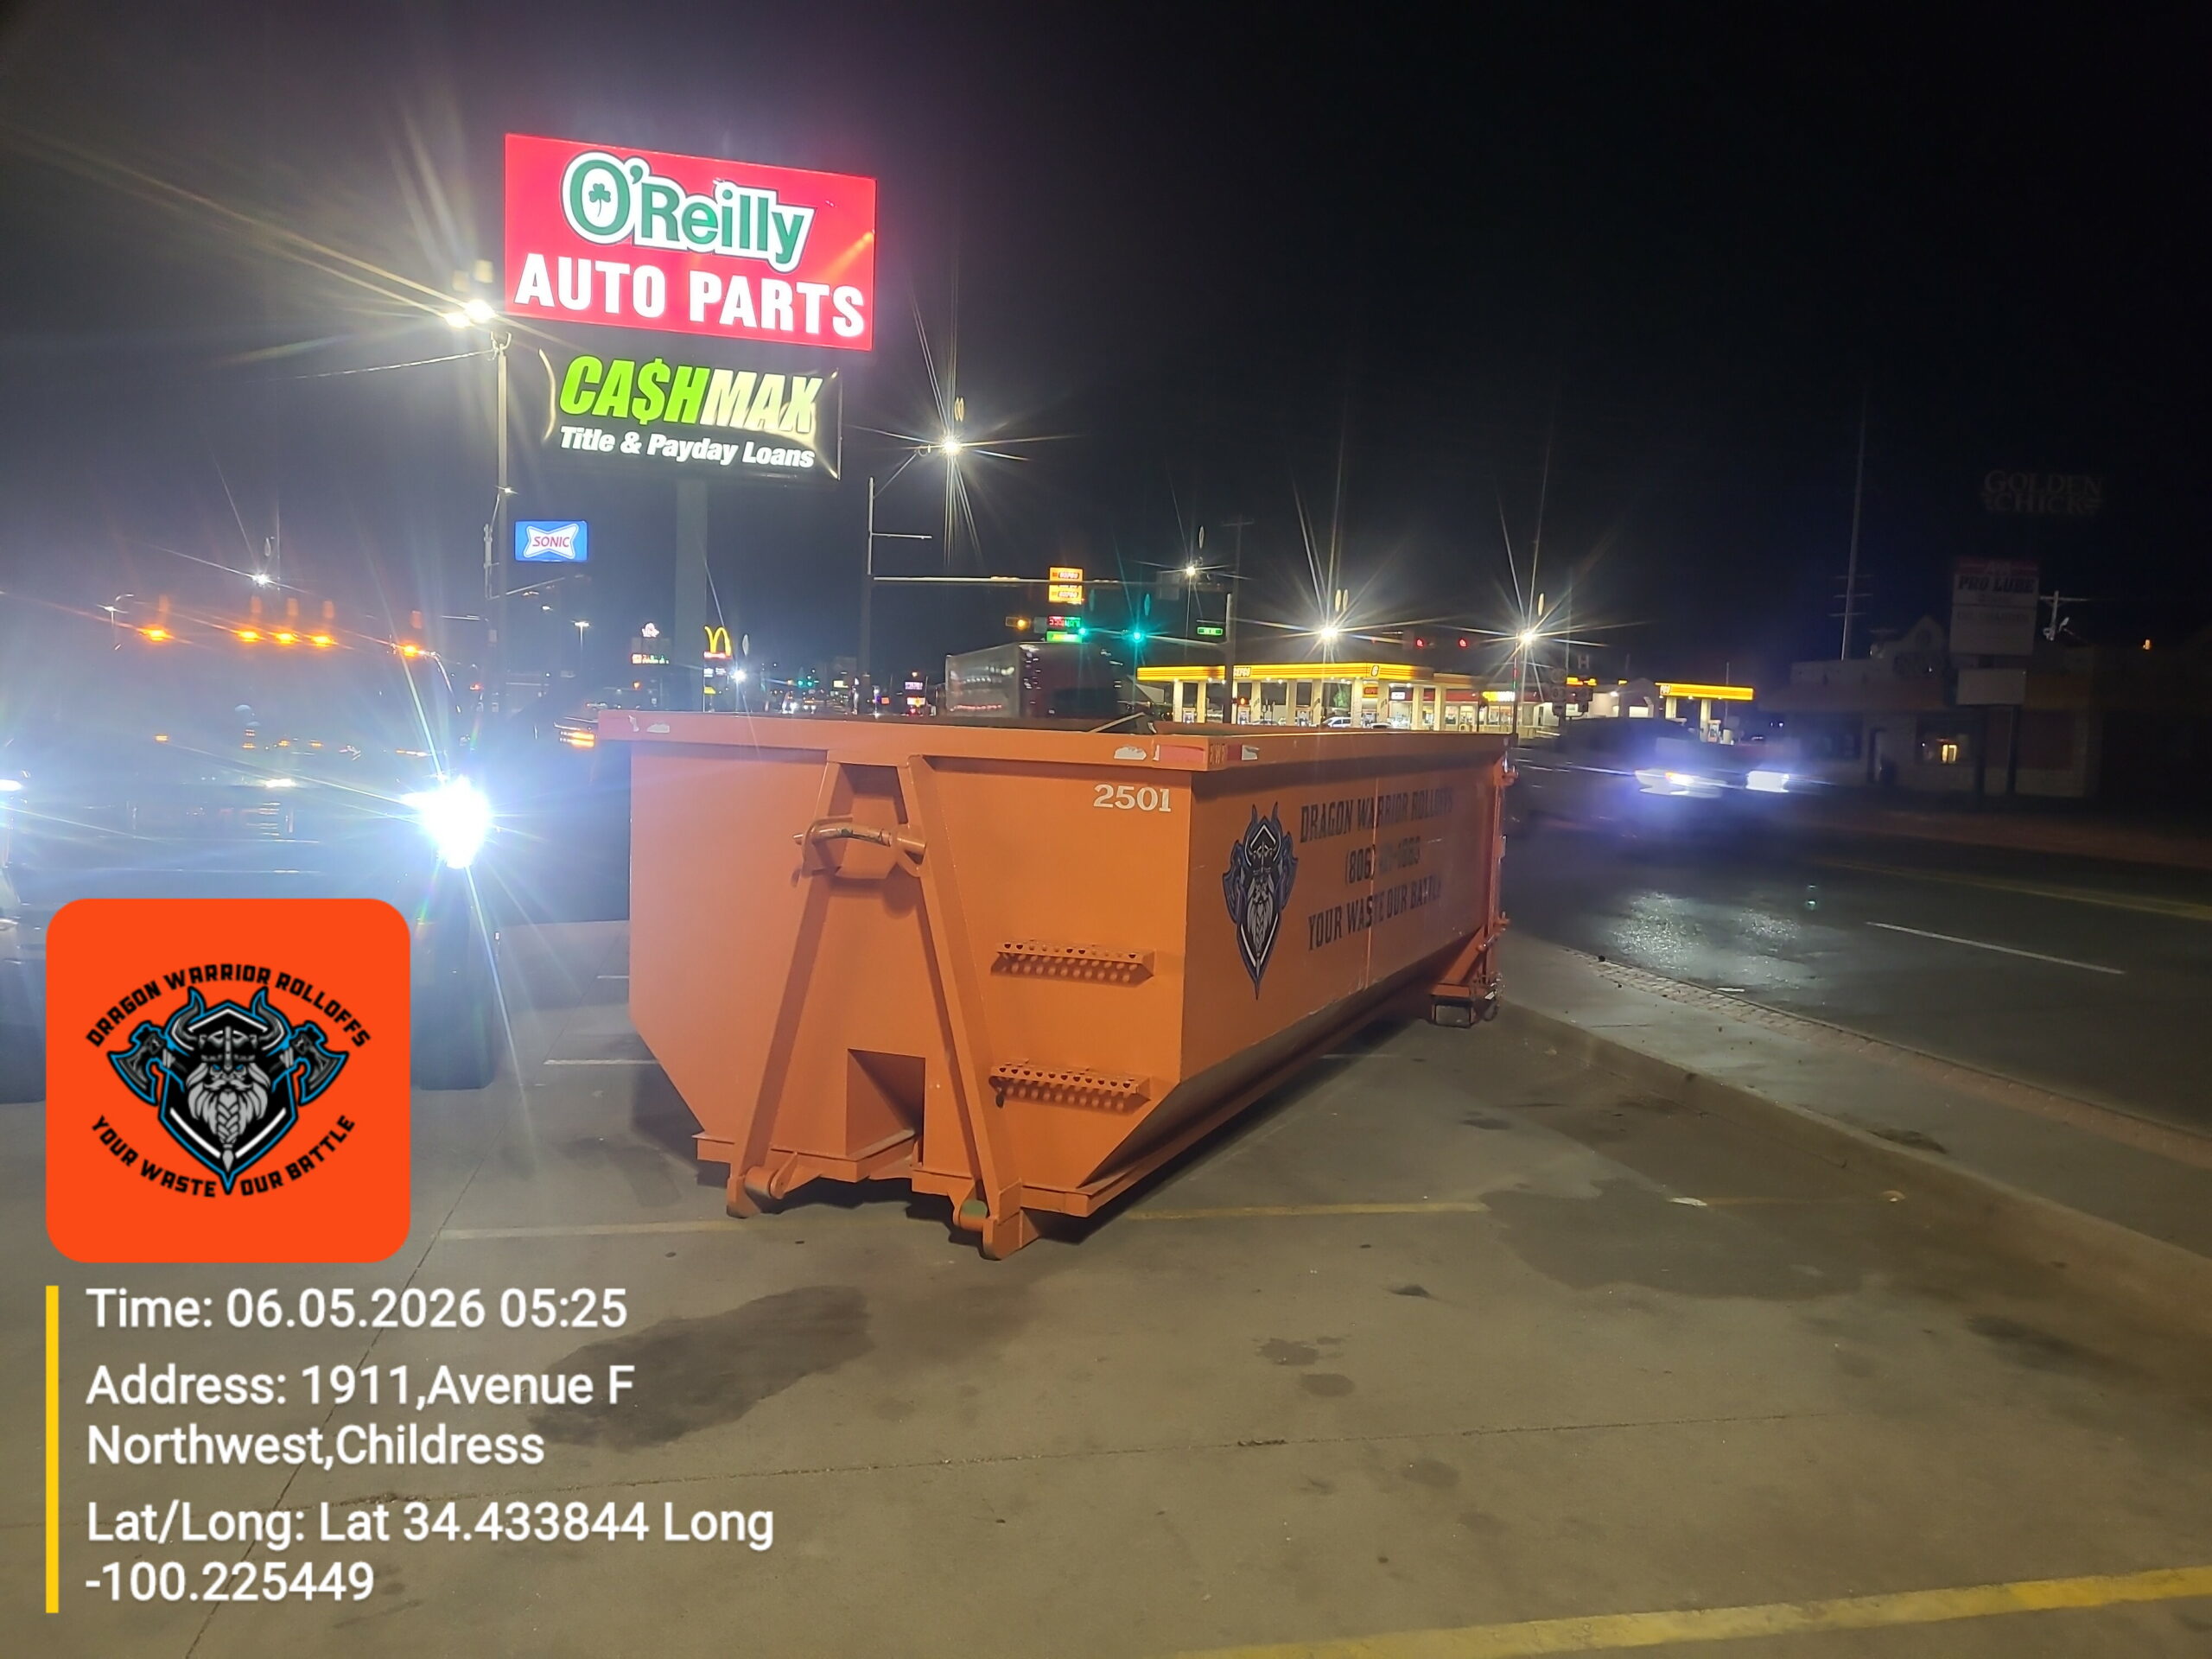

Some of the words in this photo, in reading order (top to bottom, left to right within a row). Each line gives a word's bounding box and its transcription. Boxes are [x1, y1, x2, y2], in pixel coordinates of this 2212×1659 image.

[566, 156, 810, 268] O'Reilly
[514, 253, 666, 318] AUTO
[689, 270, 864, 337] PARTS
[559, 355, 823, 434] CA$HMAX
[560, 426, 615, 453] Title
[620, 430, 643, 454] &
[647, 434, 738, 464] Payday
[742, 442, 815, 468] Loans
[1984, 469, 2101, 496] GOLDEN
[532, 536, 570, 548] SONIC
[1958, 575, 1990, 591] PRO
[1093, 785, 1172, 812] 2501
[1300, 799, 1353, 843] DRAGON
[1357, 792, 1408, 830] WARRIOR
[1308, 906, 1342, 950] YOUR
[1347, 891, 1384, 934] WASTE
[1387, 885, 1408, 918] OUR
